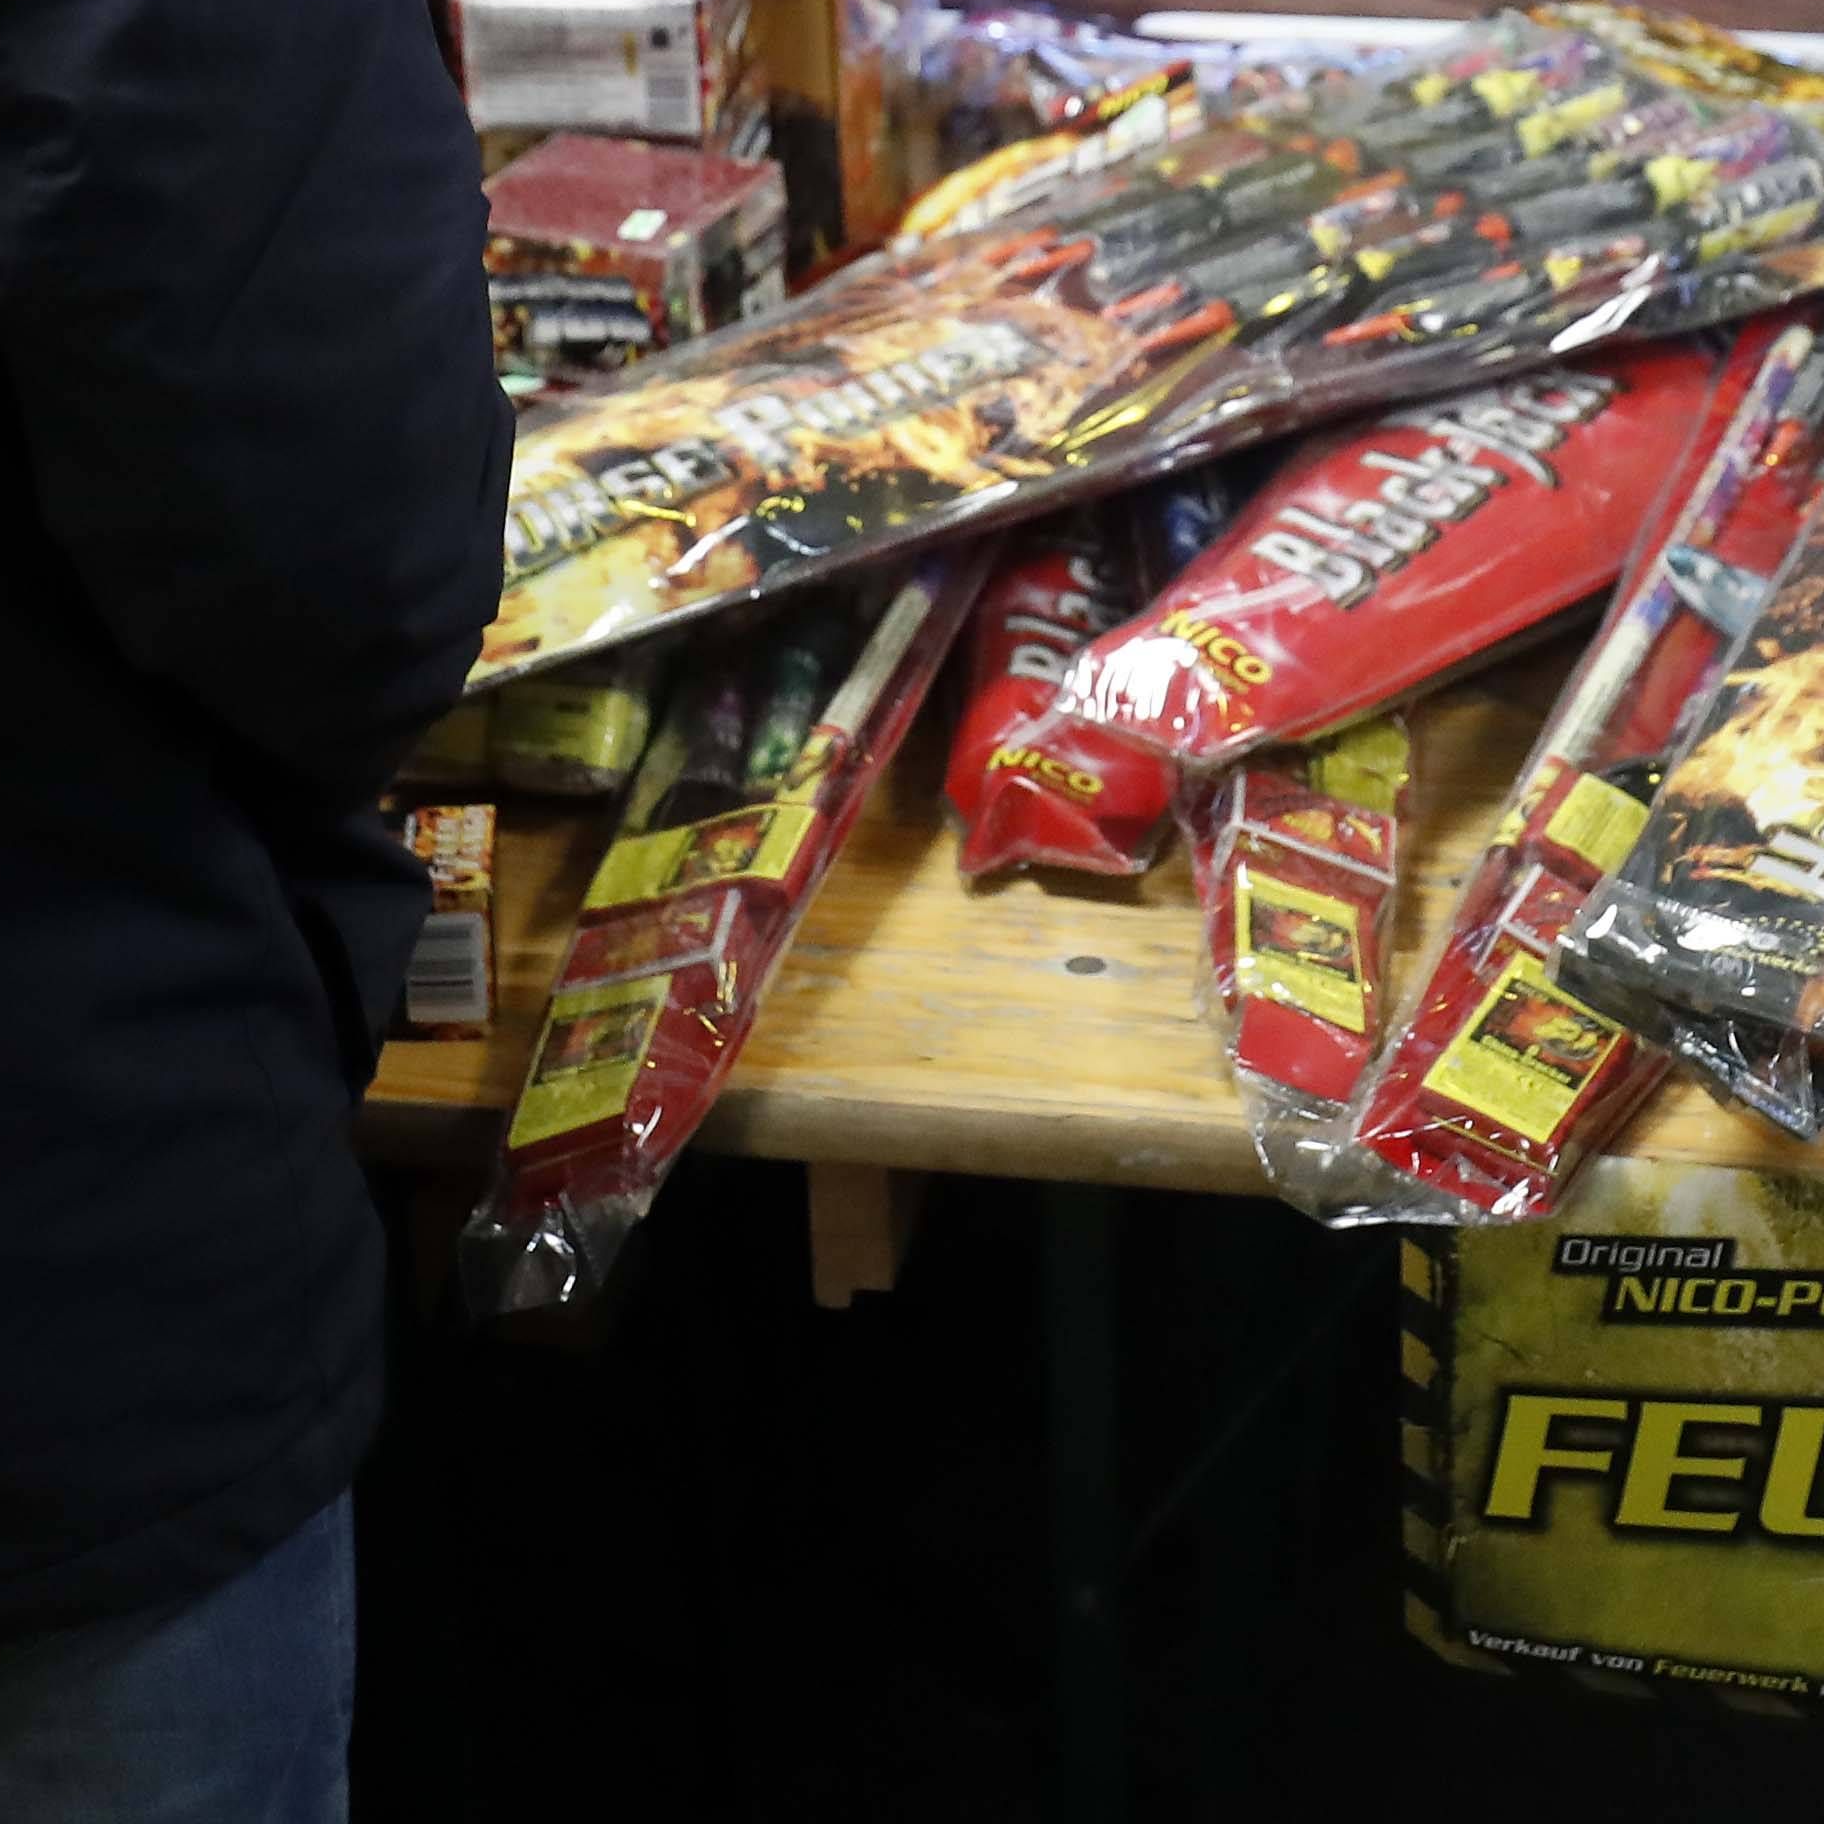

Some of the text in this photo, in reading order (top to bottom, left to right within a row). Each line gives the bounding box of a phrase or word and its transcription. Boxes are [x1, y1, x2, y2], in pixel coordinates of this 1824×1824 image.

[1159, 609, 1273, 687] NICO
[987, 745, 1105, 796] NICO
[1560, 1238, 1725, 1273] Original
[1467, 1628, 1581, 1664] Verkauf
[1591, 1651, 1645, 1676] von
[1653, 1657, 1811, 1696] Feuerwerk
